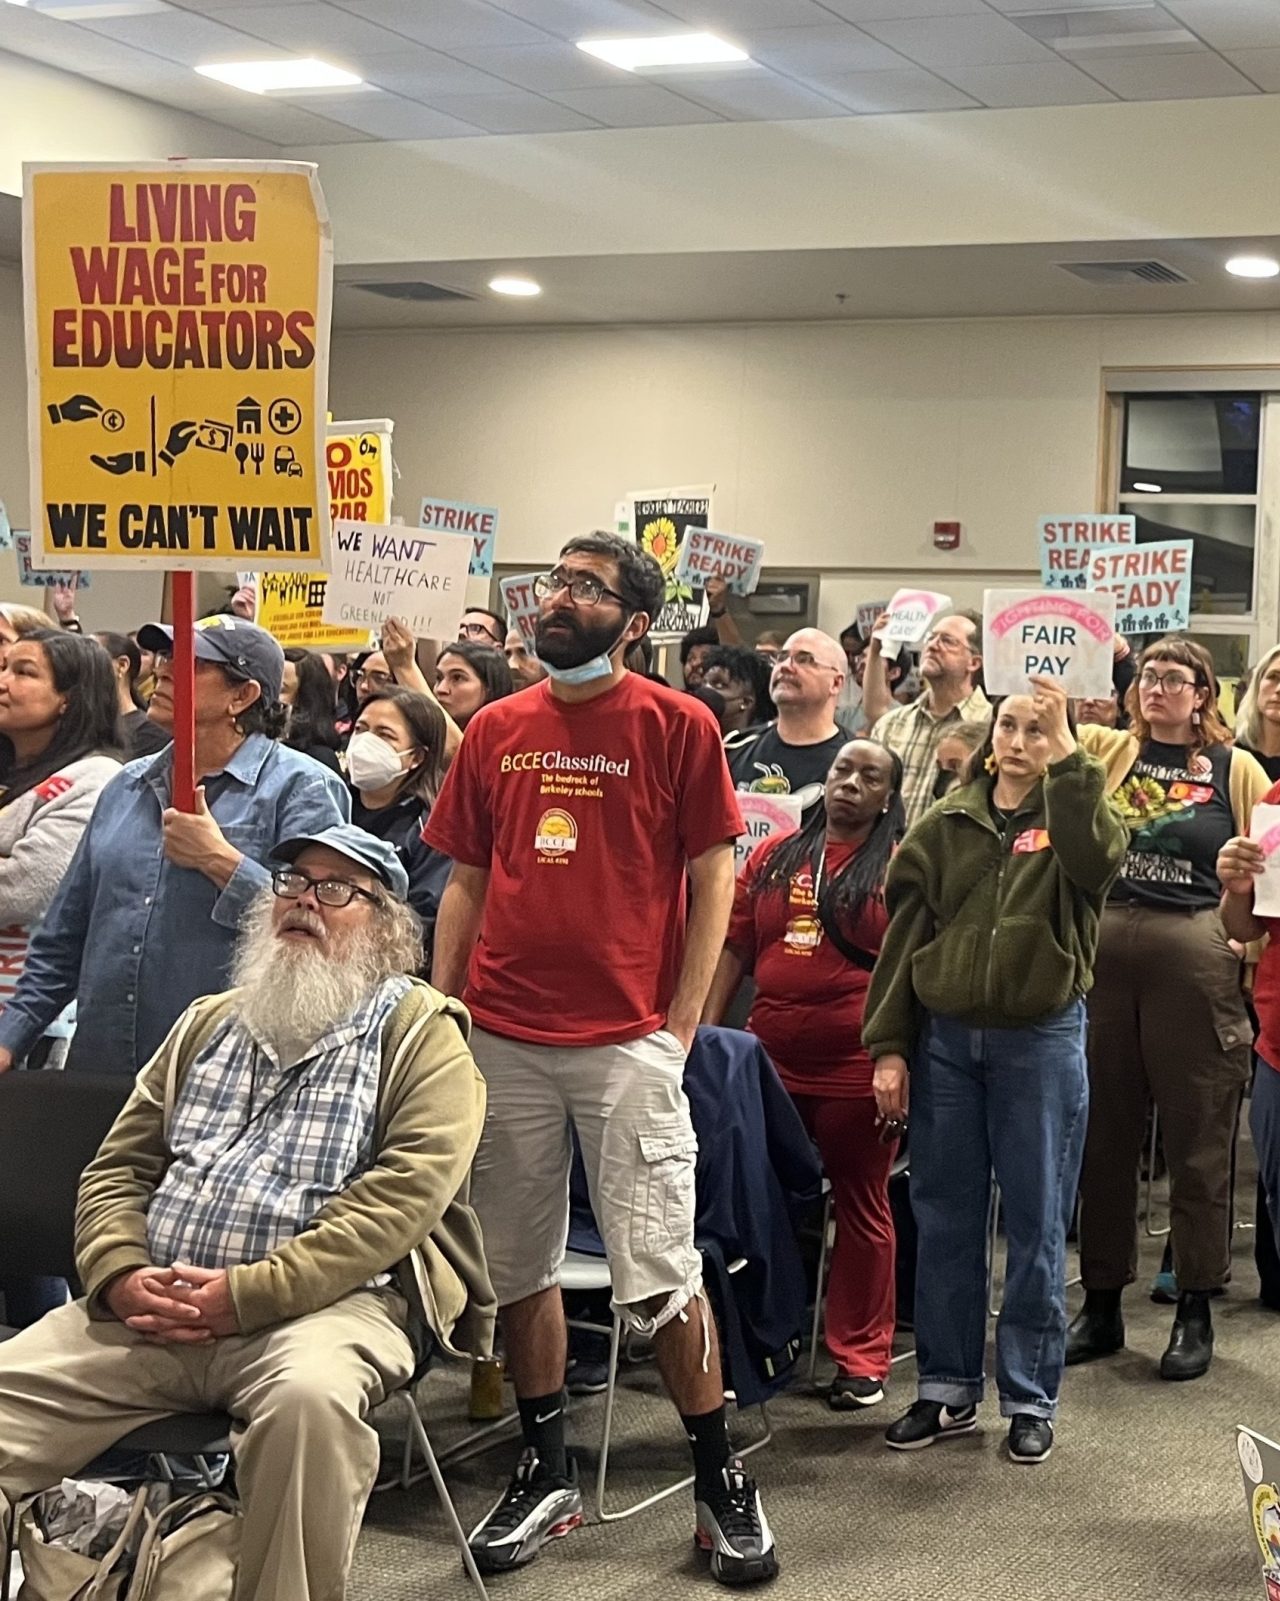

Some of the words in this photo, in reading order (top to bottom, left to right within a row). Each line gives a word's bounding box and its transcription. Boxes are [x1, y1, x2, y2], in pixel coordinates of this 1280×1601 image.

[108, 183, 257, 243] LIVING
[69, 246, 206, 306] WAGE
[211, 264, 267, 303] FOR
[52, 309, 316, 370] EDUCATORS
[326, 442, 352, 468] O
[46, 503, 107, 549] WE
[119, 504, 219, 551] CAN'T
[228, 506, 313, 553] WAIT
[422, 504, 494, 534] STRIKE
[1043, 522, 1132, 543] STRIKE
[338, 530, 362, 551] WE
[372, 534, 437, 562] WANT
[689, 533, 757, 565] STRIKE
[1048, 548, 1091, 570] REA
[345, 560, 452, 591] HEALTHCARE
[688, 552, 748, 580] READY
[1092, 549, 1187, 580] STRIKE
[372, 590, 393, 605] NOT
[1022, 625, 1076, 645] FAIR
[1025, 655, 1071, 675] PAY
